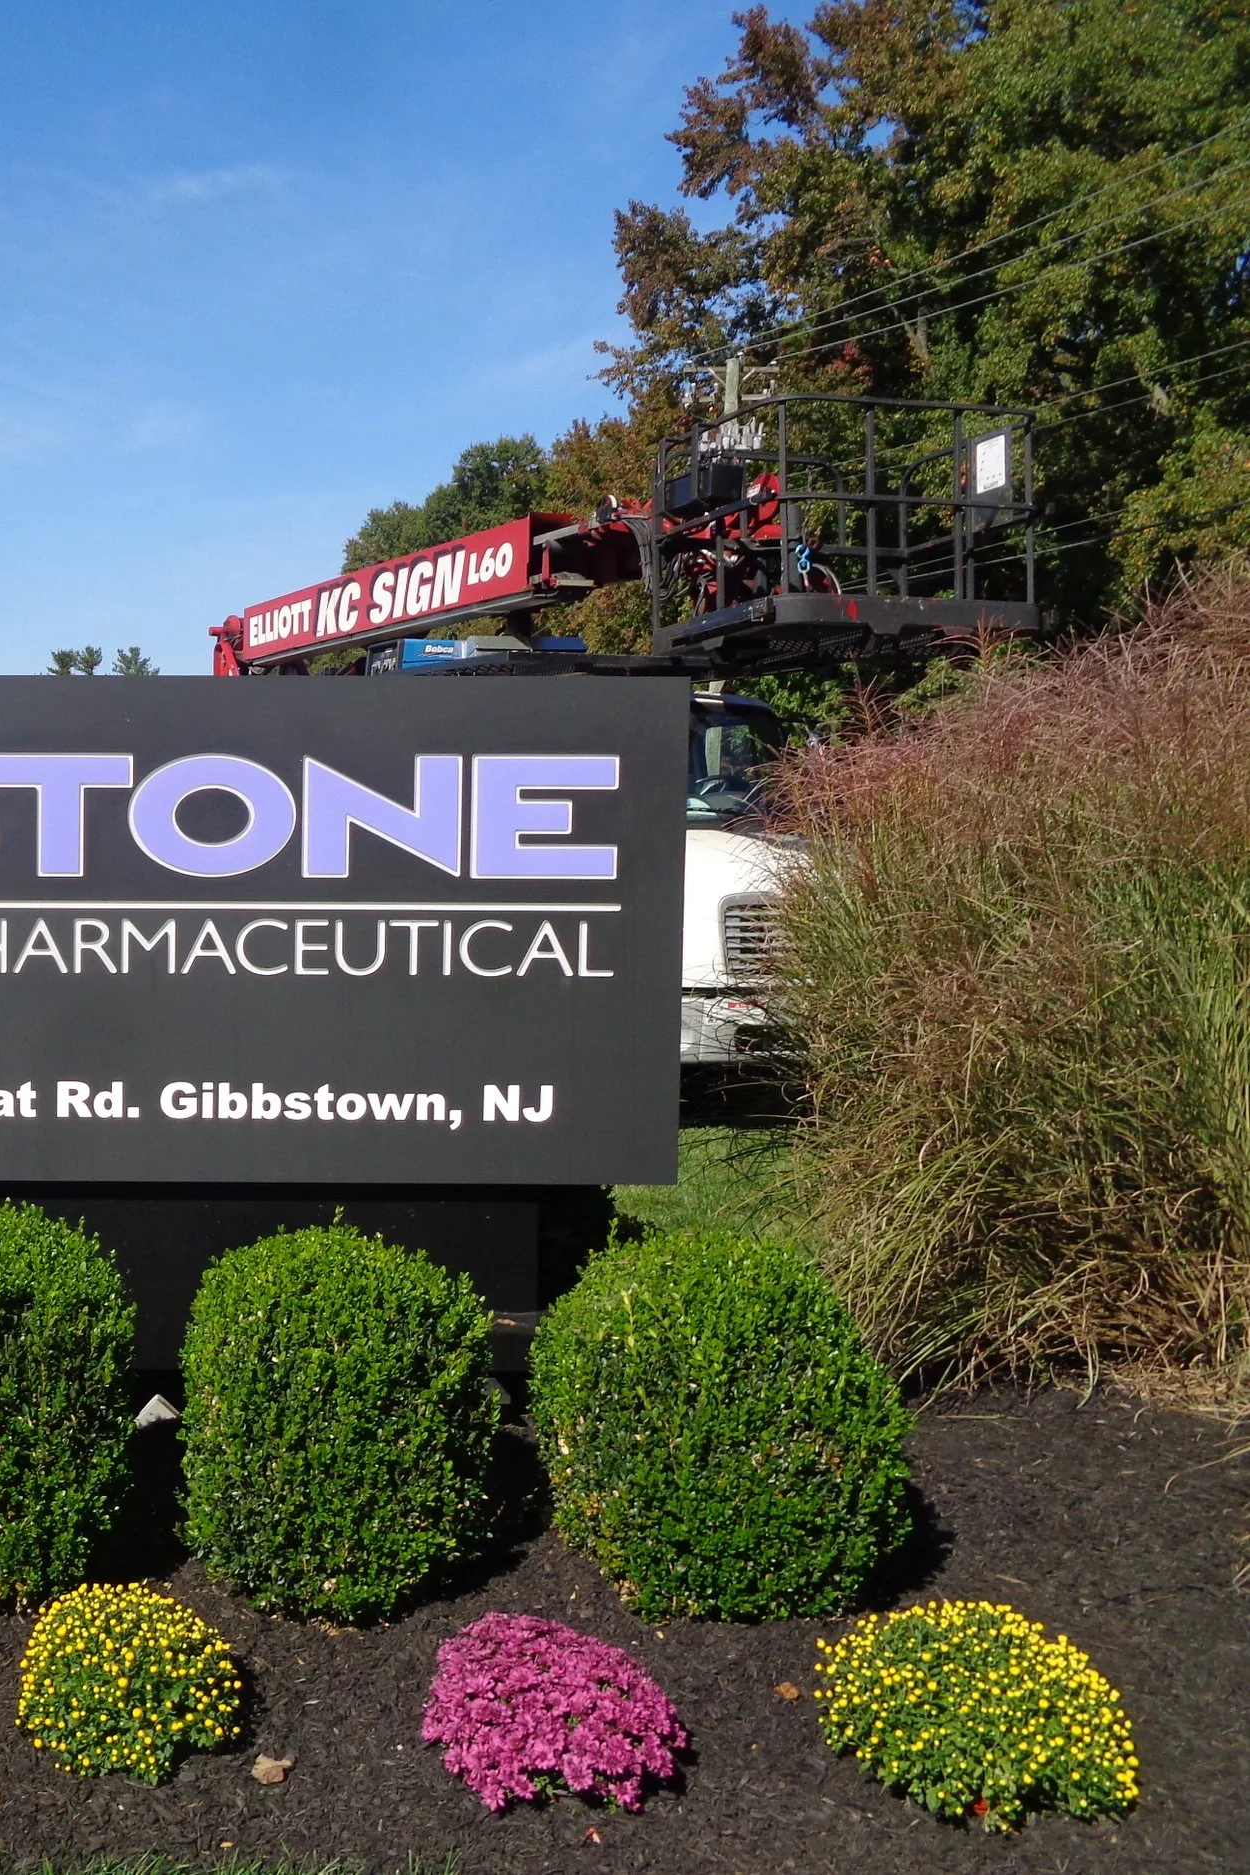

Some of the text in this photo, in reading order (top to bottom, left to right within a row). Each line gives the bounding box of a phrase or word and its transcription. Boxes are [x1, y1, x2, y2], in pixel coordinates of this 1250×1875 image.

[249, 541, 514, 647] ELLIOTT KC SIGN L60
[424, 644, 454, 654] Bobca
[56, 1080, 140, 1119] Rd.
[159, 1081, 463, 1131] Gibbstown,
[482, 1084, 554, 1123] NJ
